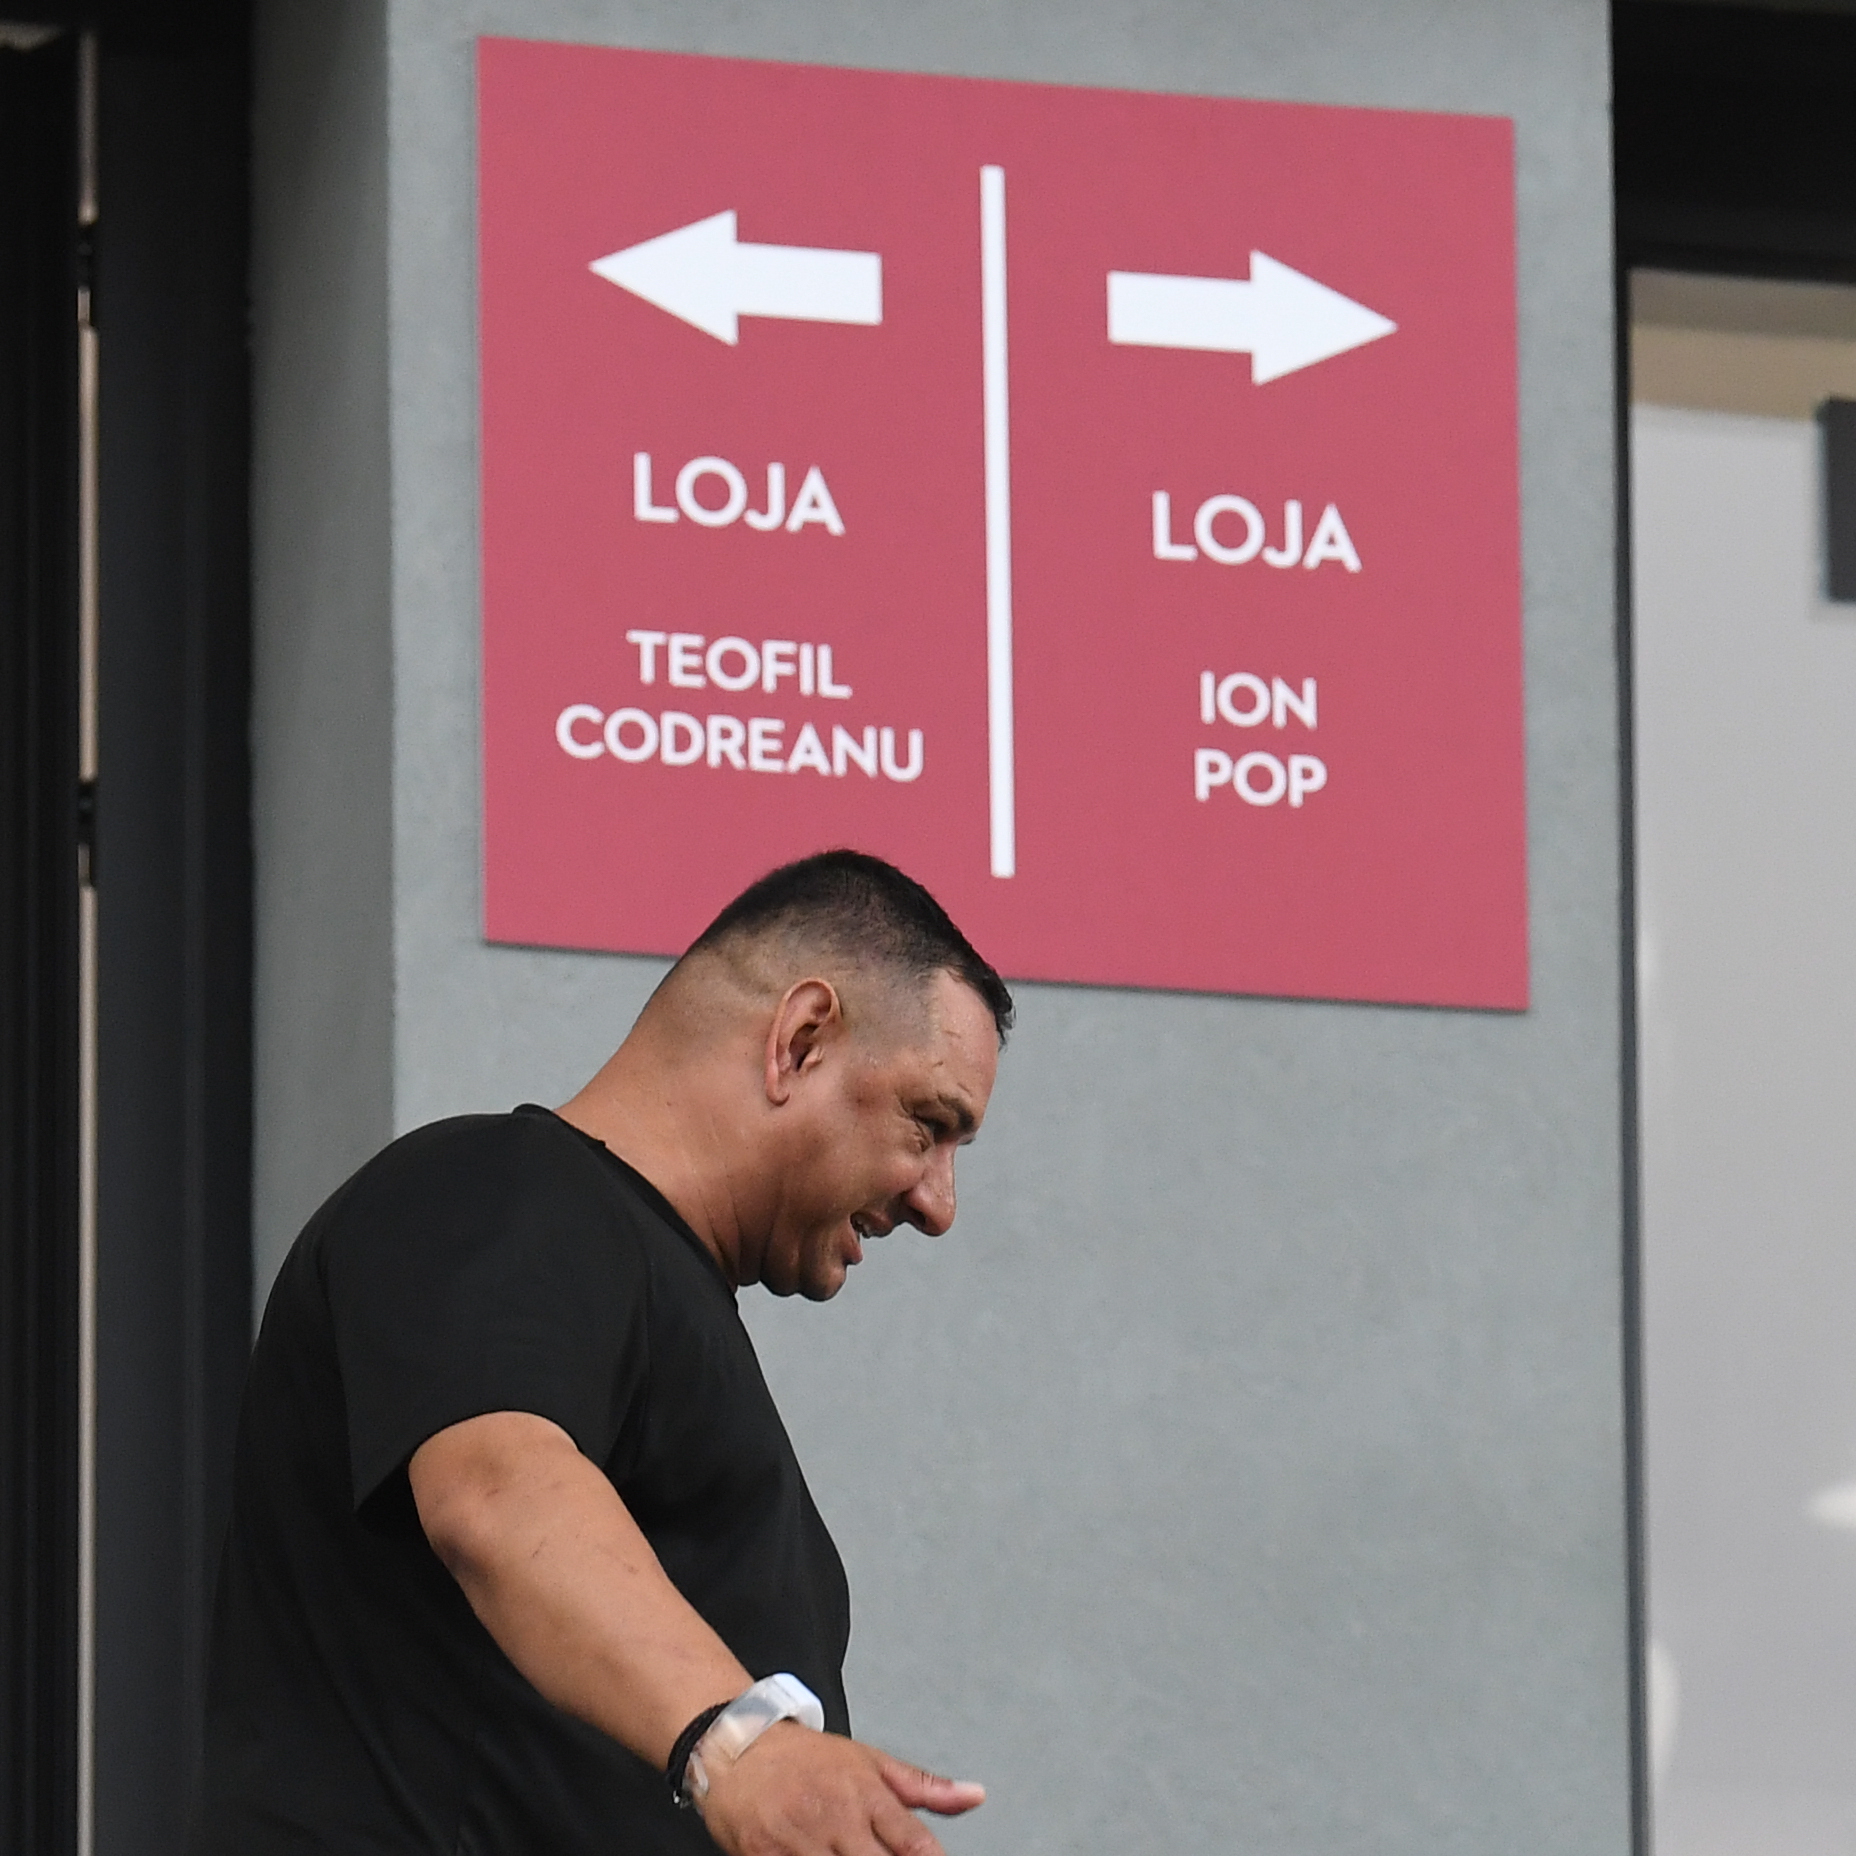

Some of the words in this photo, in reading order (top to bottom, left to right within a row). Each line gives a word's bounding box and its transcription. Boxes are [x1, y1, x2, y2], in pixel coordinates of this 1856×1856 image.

[633, 451, 846, 537] LOJA
[1152, 490, 1362, 573] LOJA
[626, 628, 852, 700] TEOFIL
[1199, 670, 1318, 730] ION
[555, 704, 925, 783] CODREANU
[1194, 748, 1328, 808] POP
